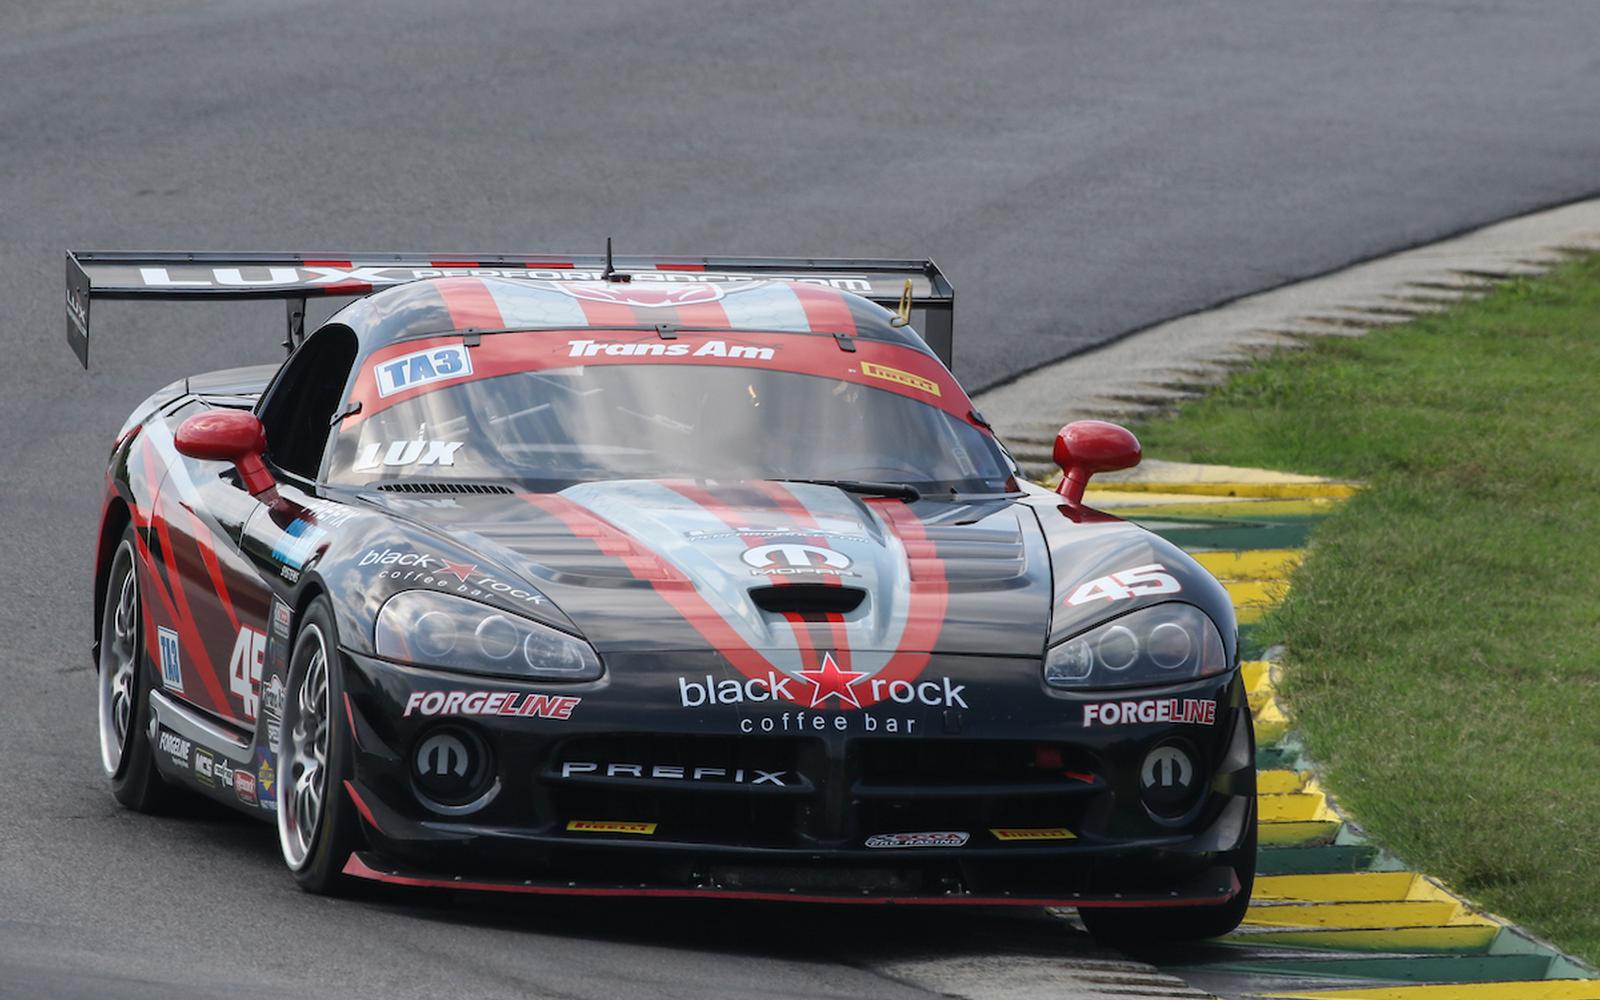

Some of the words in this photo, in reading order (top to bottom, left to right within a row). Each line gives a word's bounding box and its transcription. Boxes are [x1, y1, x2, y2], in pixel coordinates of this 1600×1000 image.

[140, 266, 390, 286] LUX
[568, 340, 690, 357] Trans
[692, 340, 775, 360] Am
[384, 349, 463, 388] TA3
[868, 365, 934, 391] PIRELLI
[352, 440, 465, 472] LUX
[358, 549, 435, 569] black
[477, 577, 546, 604] rock
[378, 570, 448, 588] coffee
[456, 584, 494, 599] bar
[1064, 563, 1182, 608] 45
[160, 635, 180, 683] TA3
[678, 671, 794, 707] black
[872, 676, 969, 709] rock
[403, 691, 582, 719] FORGELINE
[1081, 698, 1217, 728] FORGELINE
[740, 712, 848, 733] coffee
[864, 713, 916, 733] bar
[561, 761, 789, 787] PREFIX
[575, 822, 650, 831] PIRELLI
